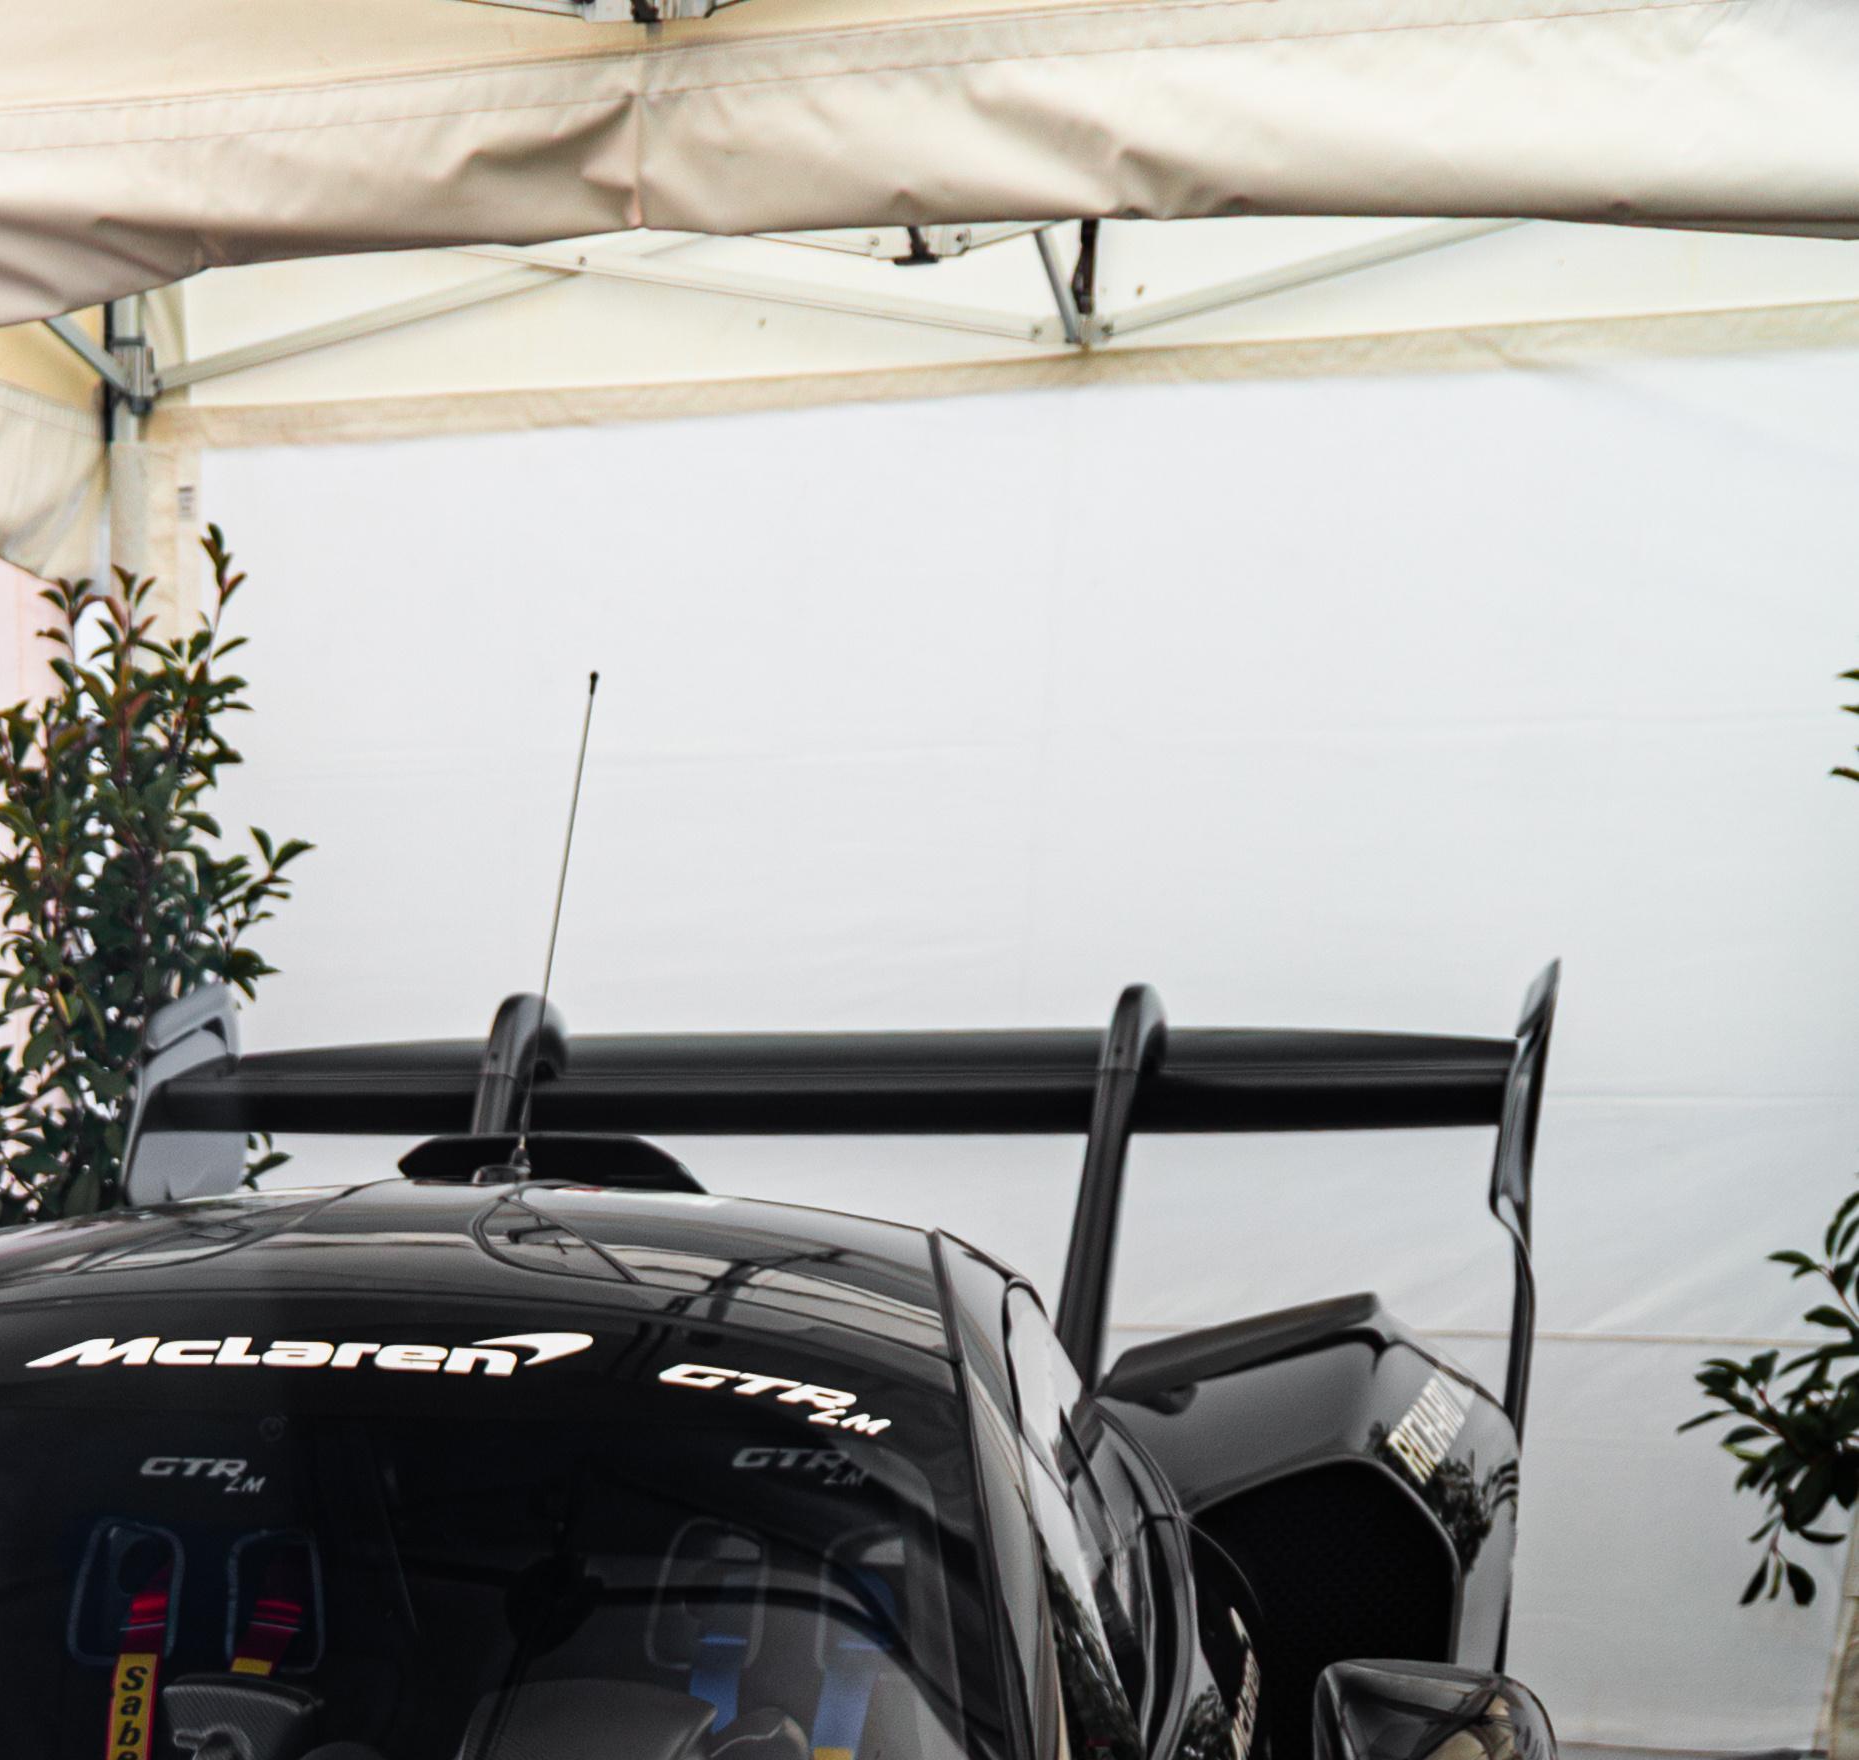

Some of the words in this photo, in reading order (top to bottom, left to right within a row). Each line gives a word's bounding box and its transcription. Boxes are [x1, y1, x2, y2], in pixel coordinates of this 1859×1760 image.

[26, 1336, 520, 1376] McLaren
[657, 1364, 857, 1410] GTR
[140, 1457, 248, 1477] GTR
